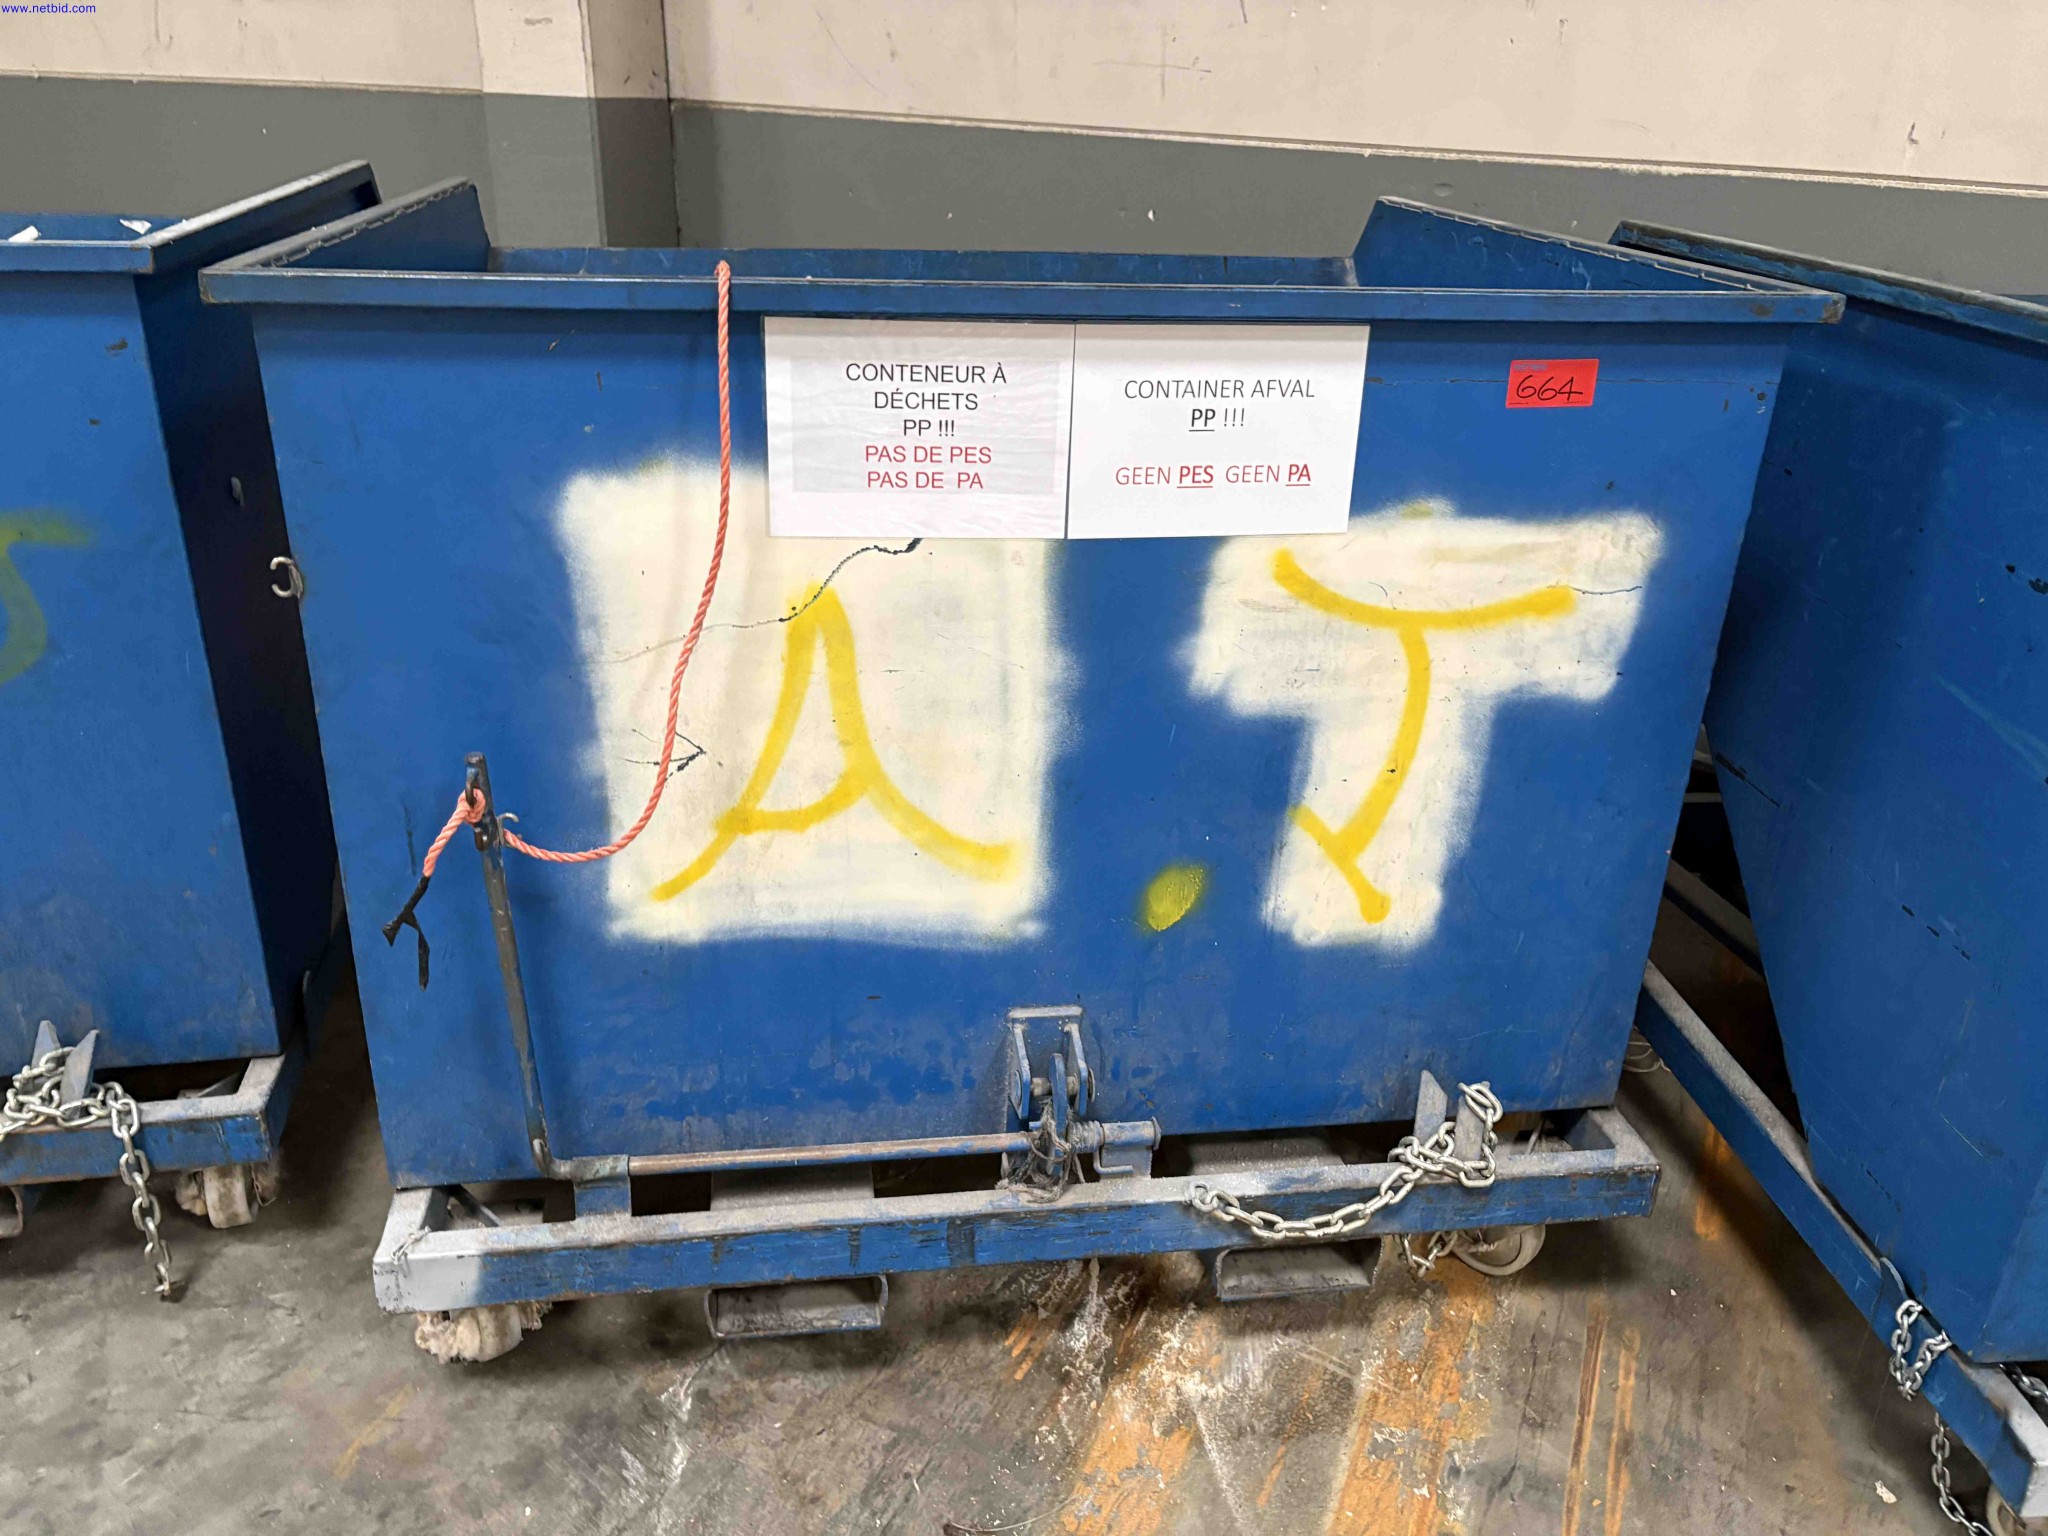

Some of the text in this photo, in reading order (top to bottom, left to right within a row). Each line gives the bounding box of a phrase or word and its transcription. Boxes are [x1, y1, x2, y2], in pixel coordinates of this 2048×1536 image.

[845, 361, 1008, 384] CONTENEUR À
[874, 388, 979, 411] DÉCHETS
[1124, 378, 1316, 399] CONTAINER AFVAL
[1516, 374, 1584, 402] 664
[903, 419, 956, 437] PP !!!
[1189, 407, 1246, 432] PP !!!
[865, 445, 993, 465] PAS DE PES
[867, 471, 984, 489] PAS DE PA
[1115, 463, 1312, 488] GEEN PES GEEN PA
